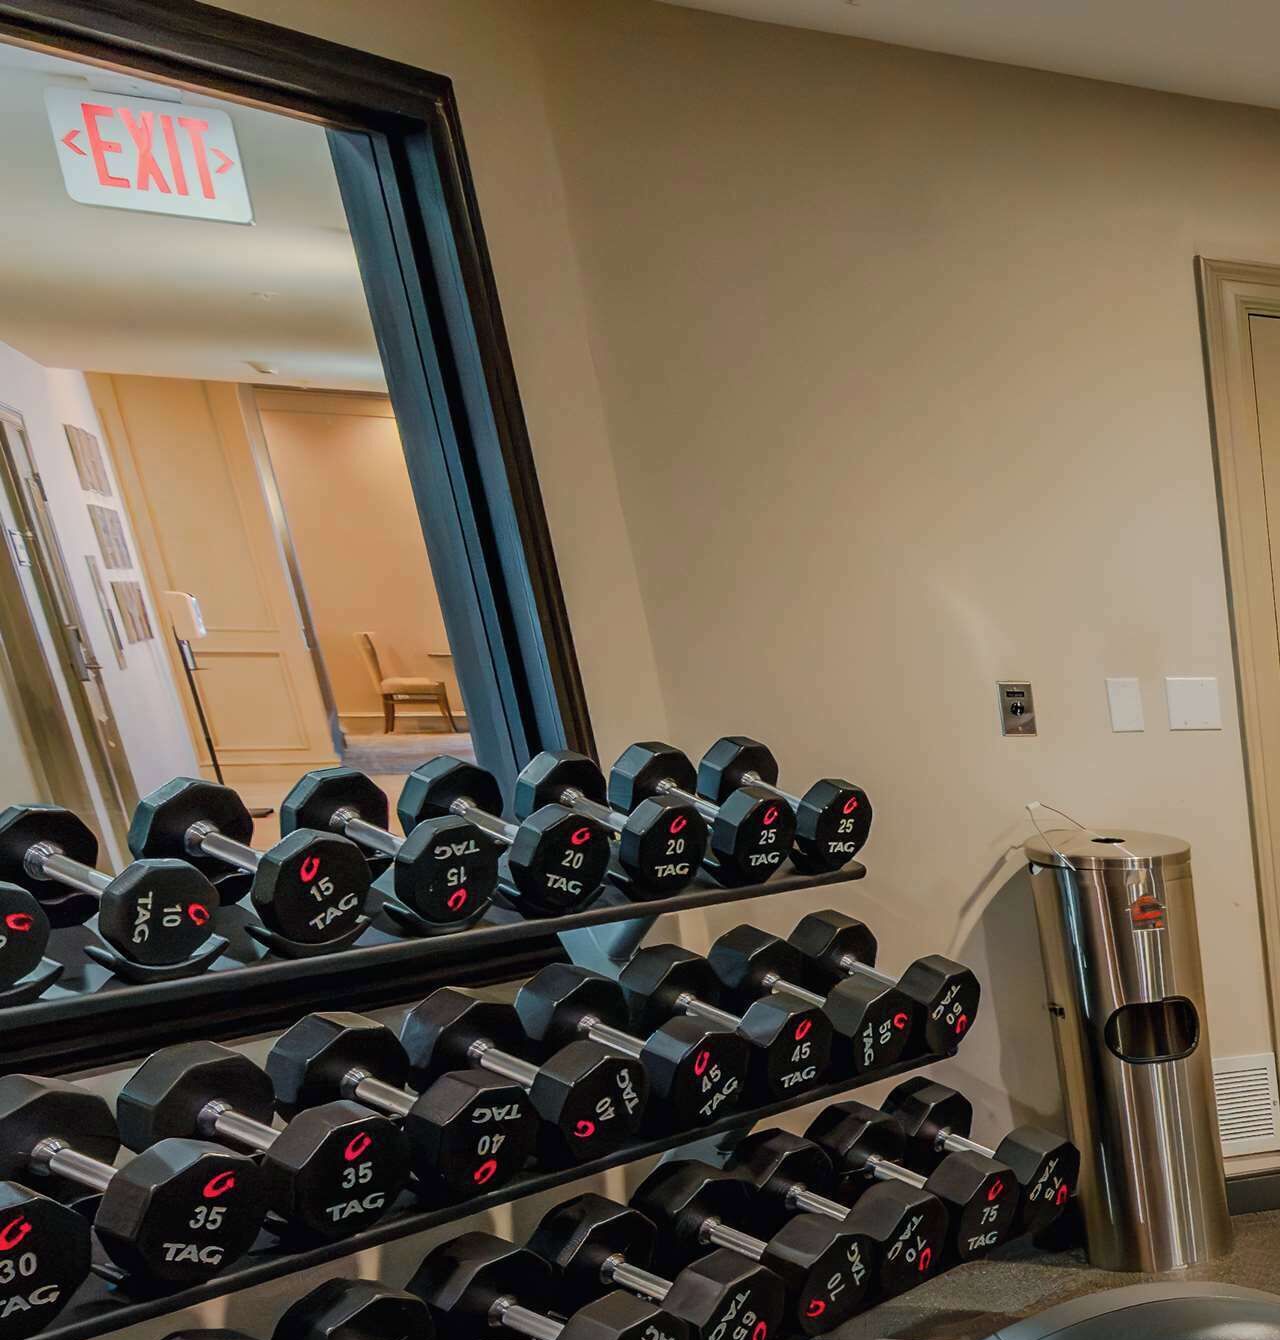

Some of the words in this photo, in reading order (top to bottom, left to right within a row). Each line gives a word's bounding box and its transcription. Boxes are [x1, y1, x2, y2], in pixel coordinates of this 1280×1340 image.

[81, 103, 219, 200] EXIT
[759, 828, 777, 845] 25
[837, 819, 854, 834] 25
[433, 839, 480, 860] TAG
[666, 839, 685, 855] 20
[749, 851, 780, 866] TAG
[828, 841, 856, 853] TAG
[561, 850, 584, 870] 20
[654, 863, 690, 877] TAG
[447, 866, 468, 887] 15
[545, 873, 584, 896] TAG
[310, 877, 334, 902] 15
[131, 891, 153, 944] TAG
[162, 904, 182, 928] 10
[309, 893, 358, 931] TAG
[932, 984, 961, 1020] TAG
[863, 1022, 875, 1067] TAG
[879, 1019, 892, 1045] 50
[791, 1042, 812, 1063] 45
[701, 1064, 721, 1093] 45
[780, 1065, 817, 1088] TAG
[615, 1068, 640, 1115] TAG
[699, 1076, 739, 1117] TAG
[471, 1103, 522, 1124] TAG
[594, 1097, 616, 1122] 40
[477, 1134, 506, 1157] 40
[341, 1161, 374, 1189] 35
[1029, 1157, 1059, 1202] TAG
[188, 1206, 228, 1231] 35
[325, 1192, 385, 1222] TAG
[980, 1205, 1000, 1225] 75
[887, 1214, 924, 1261] TAG
[905, 1235, 927, 1263] 70
[967, 1231, 998, 1251] TAG
[162, 1242, 225, 1265] TAG
[846, 1242, 867, 1286] TAG
[0, 1252, 38, 1284] 30
[0, 1284, 61, 1318] AG
